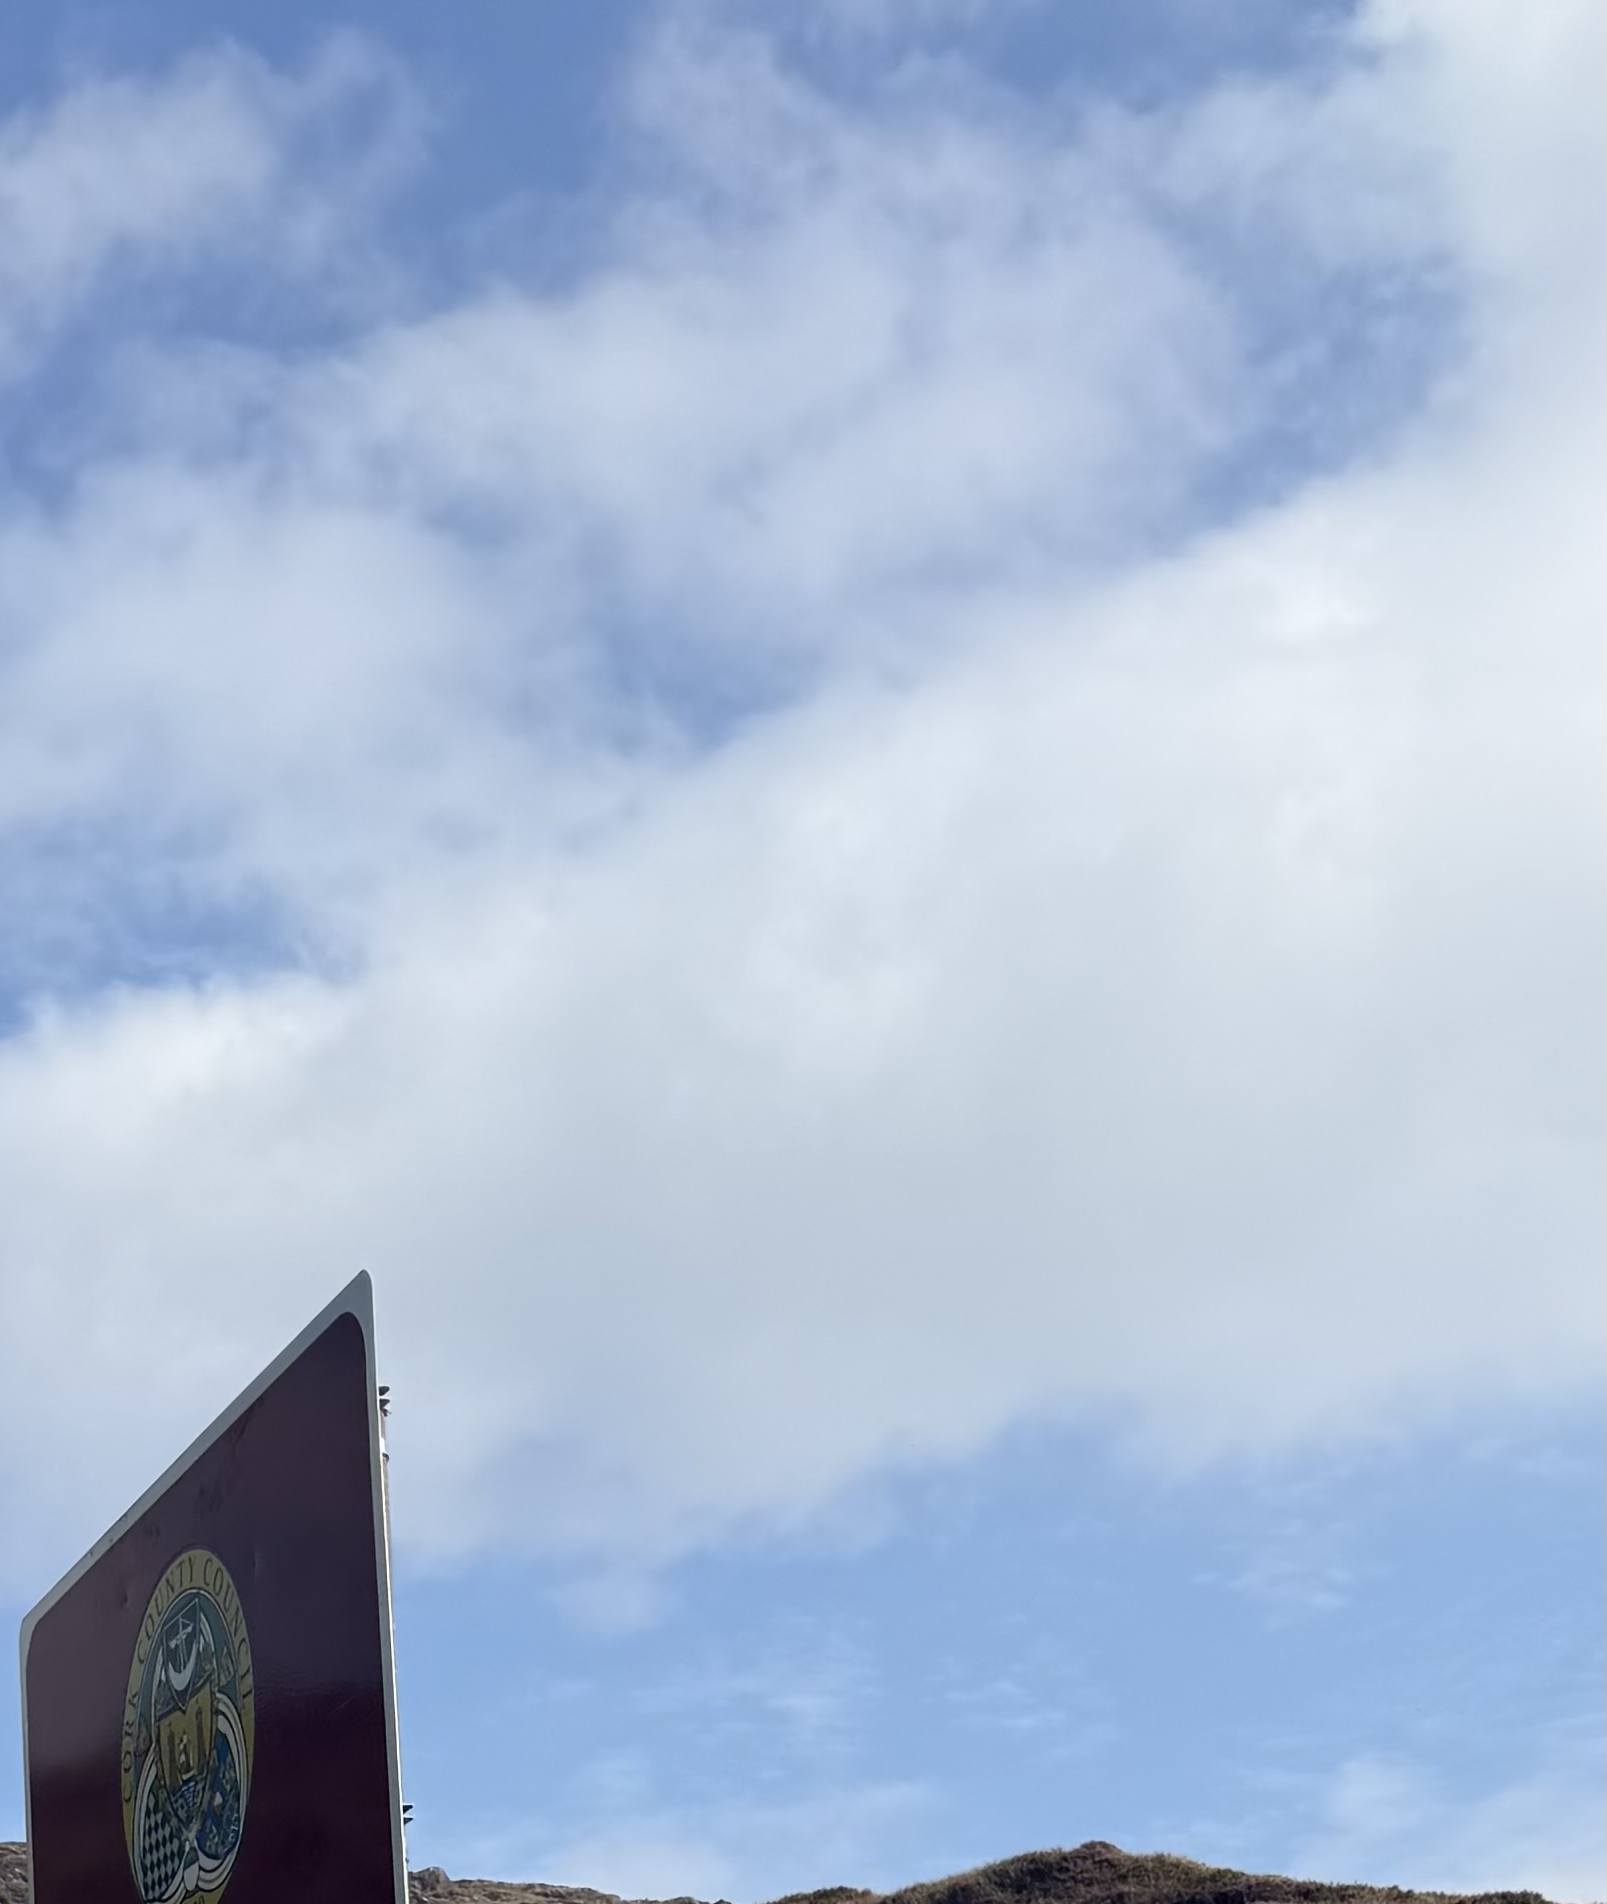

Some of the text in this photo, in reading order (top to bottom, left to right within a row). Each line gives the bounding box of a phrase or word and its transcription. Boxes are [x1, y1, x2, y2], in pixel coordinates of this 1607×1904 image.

[121, 1555, 253, 1804] CORK COUNTY COUNCIL
